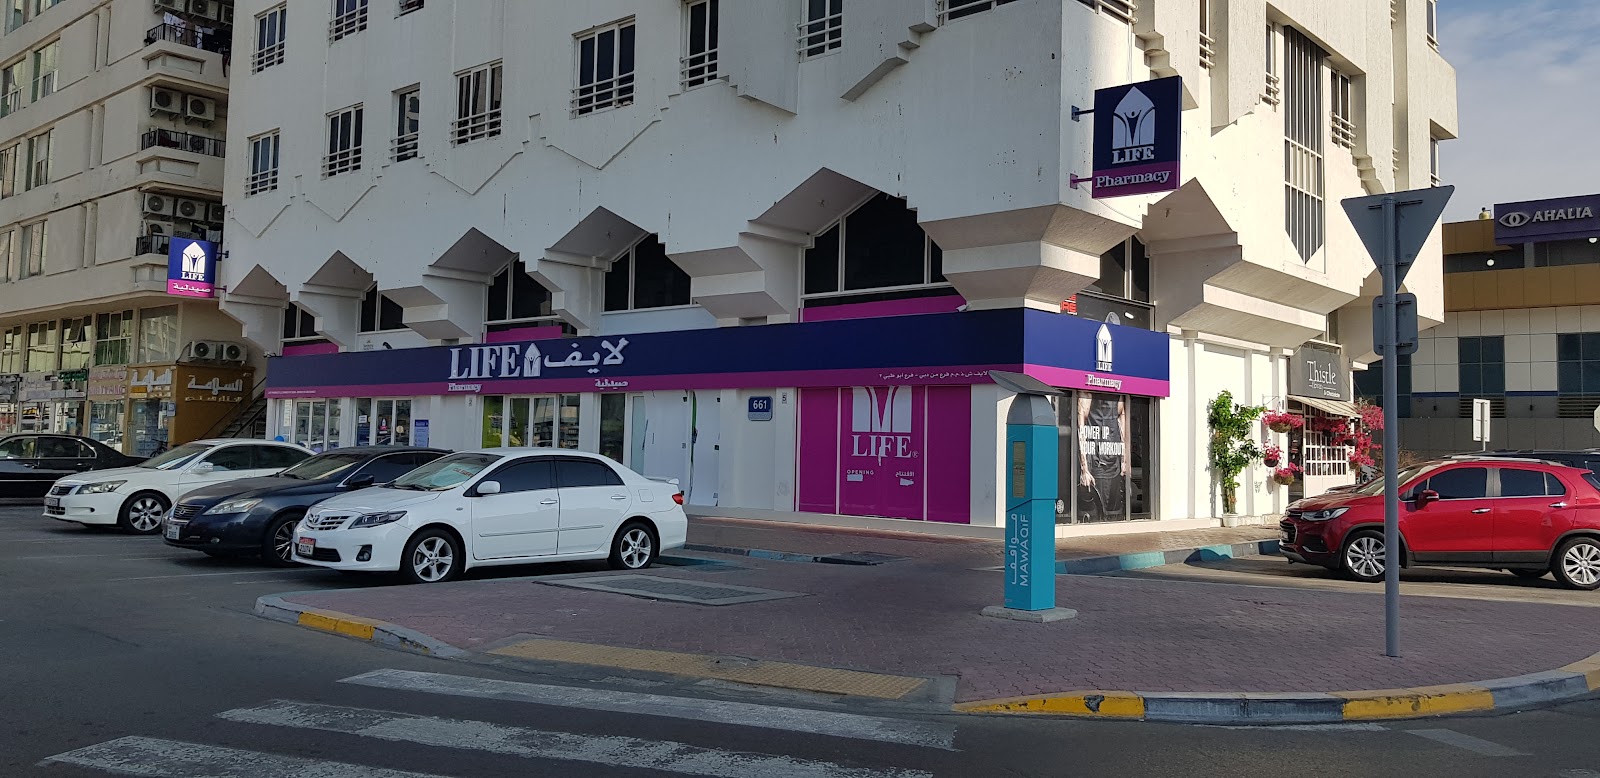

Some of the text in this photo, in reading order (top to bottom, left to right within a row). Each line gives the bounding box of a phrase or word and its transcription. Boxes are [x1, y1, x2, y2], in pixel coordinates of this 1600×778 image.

[1112, 146, 1155, 164] LIFE
[1095, 171, 1171, 188] Pharmacy
[1532, 207, 1593, 222] AHALIA
[181, 272, 205, 281] LIFE
[173, 283, 211, 294] صيدلية
[448, 345, 521, 380] LIFE
[544, 337, 630, 374] لايف
[1096, 362, 1112, 371] LIFE
[1307, 360, 1336, 385] Thistle
[595, 379, 629, 390] صيدلية
[1085, 374, 1122, 391] Pharmacy
[753, 400, 767, 410] 661
[1080, 425, 1110, 440] POWER UP
[1080, 441, 1124, 456] YOUR WORKOUT
